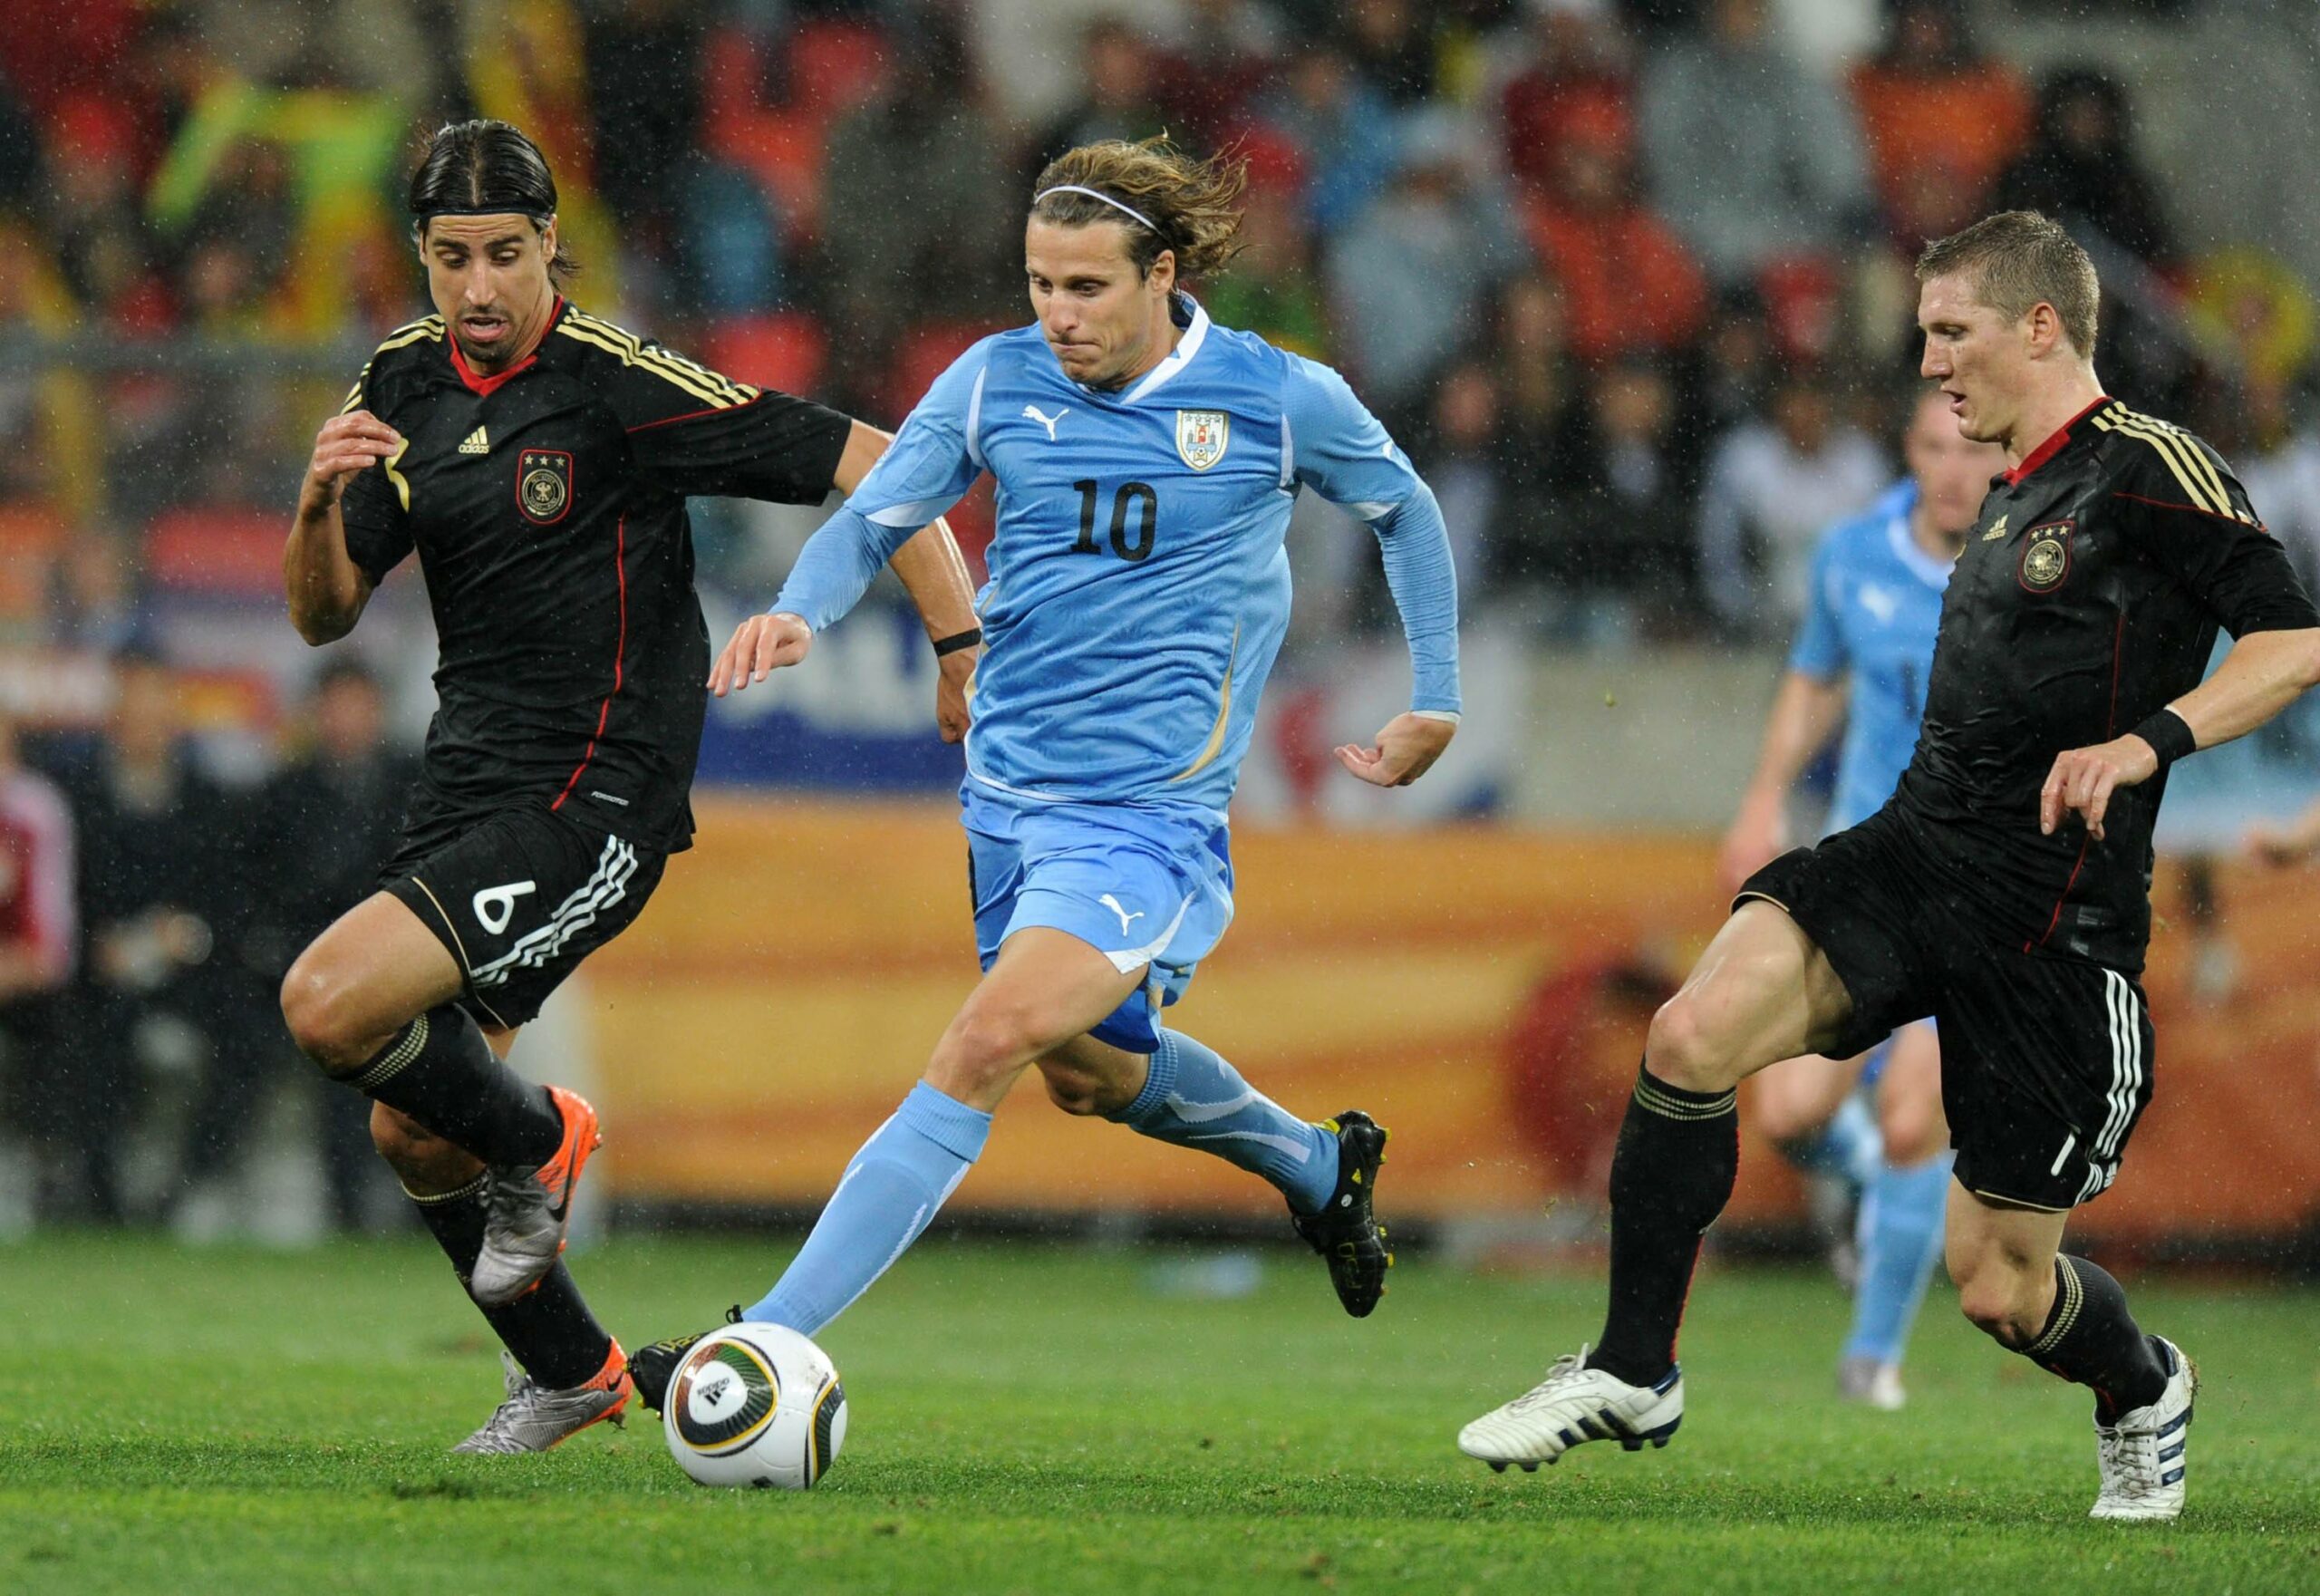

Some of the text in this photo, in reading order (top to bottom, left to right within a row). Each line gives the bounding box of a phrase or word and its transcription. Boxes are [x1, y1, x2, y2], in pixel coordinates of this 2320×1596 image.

[459, 443, 490, 454] adidas
[1070, 479, 1157, 562] 10
[472, 880, 536, 935] 6
[697, 1378, 730, 1396] adidas
